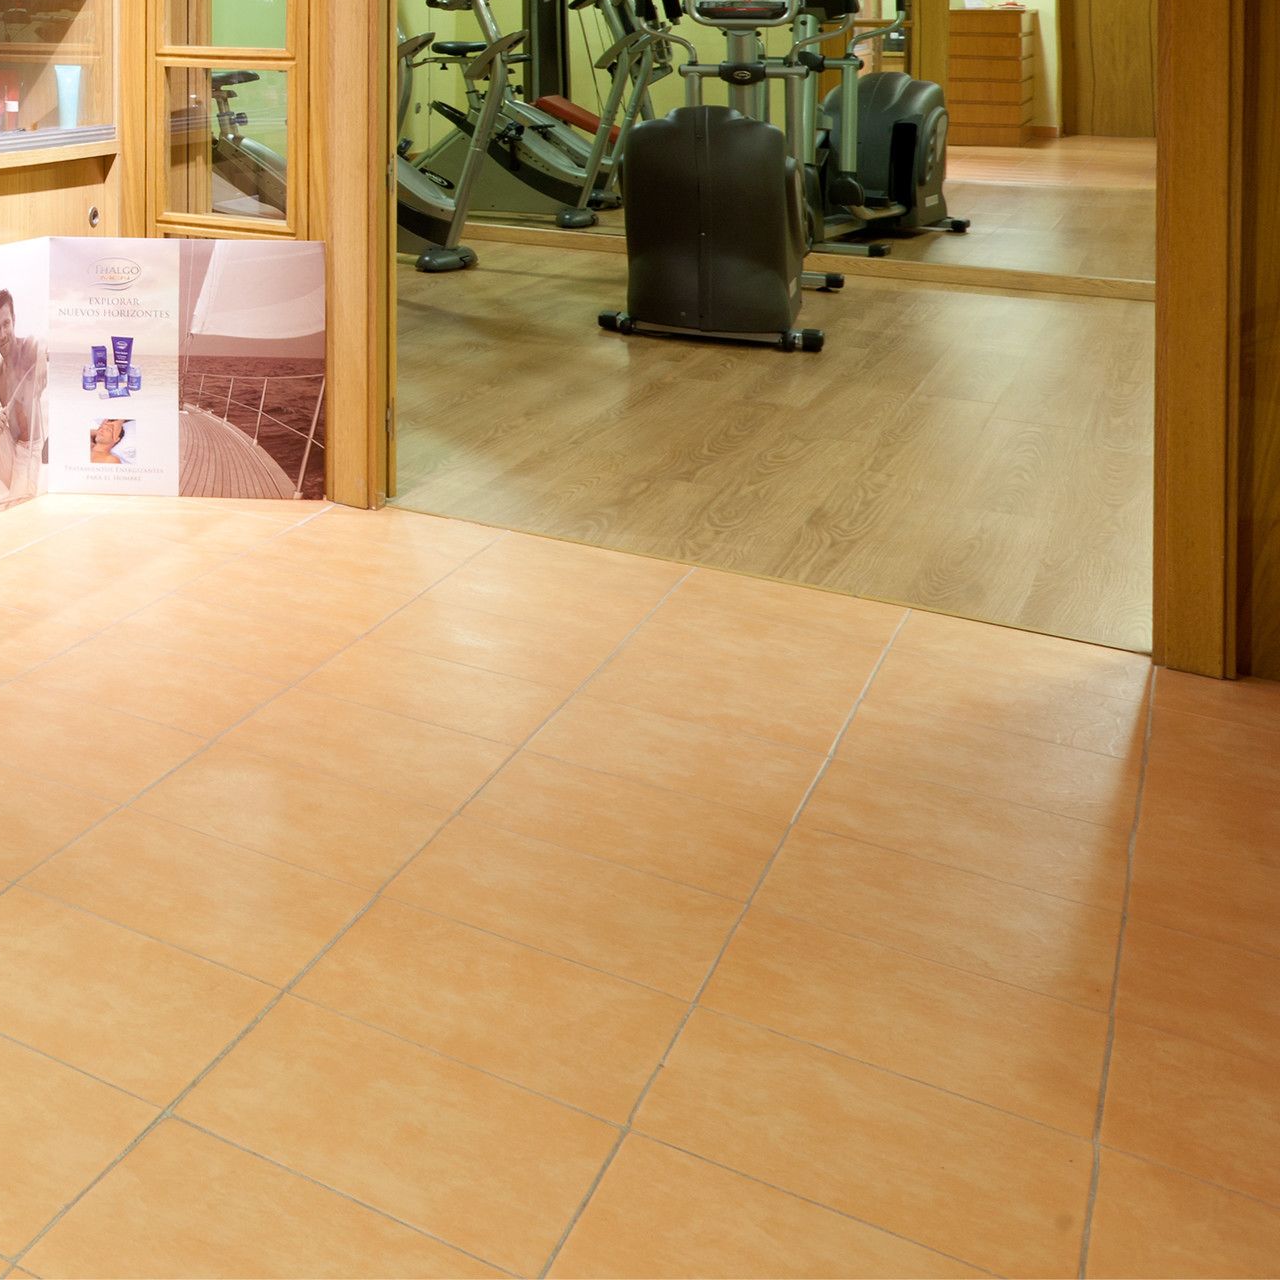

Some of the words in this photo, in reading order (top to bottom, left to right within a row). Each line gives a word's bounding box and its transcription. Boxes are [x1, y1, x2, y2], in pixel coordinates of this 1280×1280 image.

[95, 264, 140, 275] THALGO
[88, 296, 140, 306] EXPLORAR
[58, 307, 100, 317] NUEVOS
[103, 308, 170, 318] HORIZONTES
